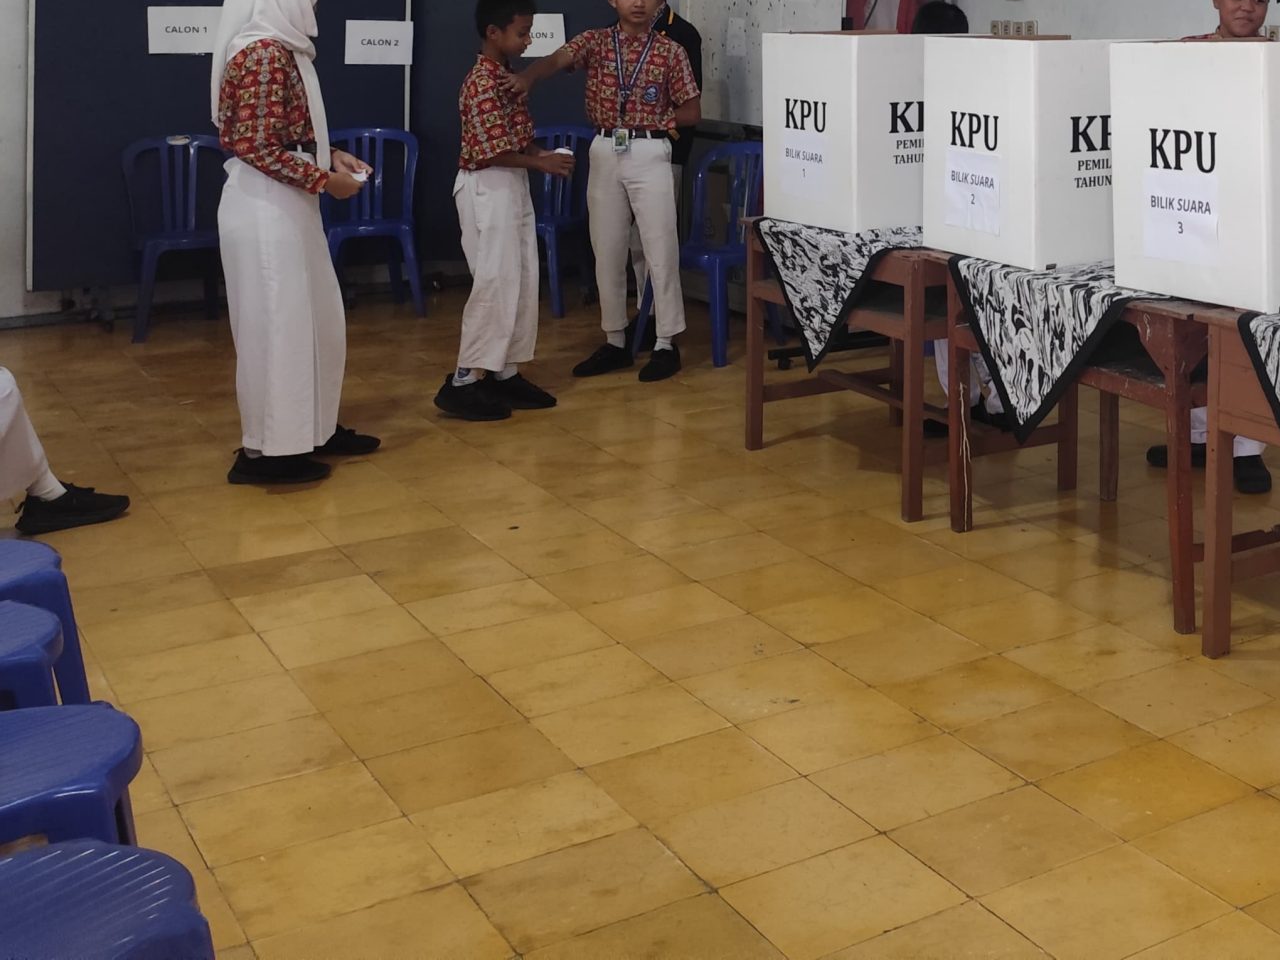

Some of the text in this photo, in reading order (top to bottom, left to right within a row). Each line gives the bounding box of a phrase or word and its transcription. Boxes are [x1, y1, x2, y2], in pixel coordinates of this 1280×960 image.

[164, 25, 208, 34] CALON 1
[360, 38, 400, 47] CALON 2
[785, 98, 827, 133] KPU
[950, 111, 999, 151] KPU
[785, 147, 823, 164] BILIK SUARA
[1149, 128, 1217, 174] KPU
[1077, 158, 1111, 171] PEMIL
[951, 170, 995, 190] BILIK SUARA
[970, 193, 976, 205] 2
[1150, 195, 1212, 215] BILIK SUARA
[1177, 221, 1184, 234] 3
